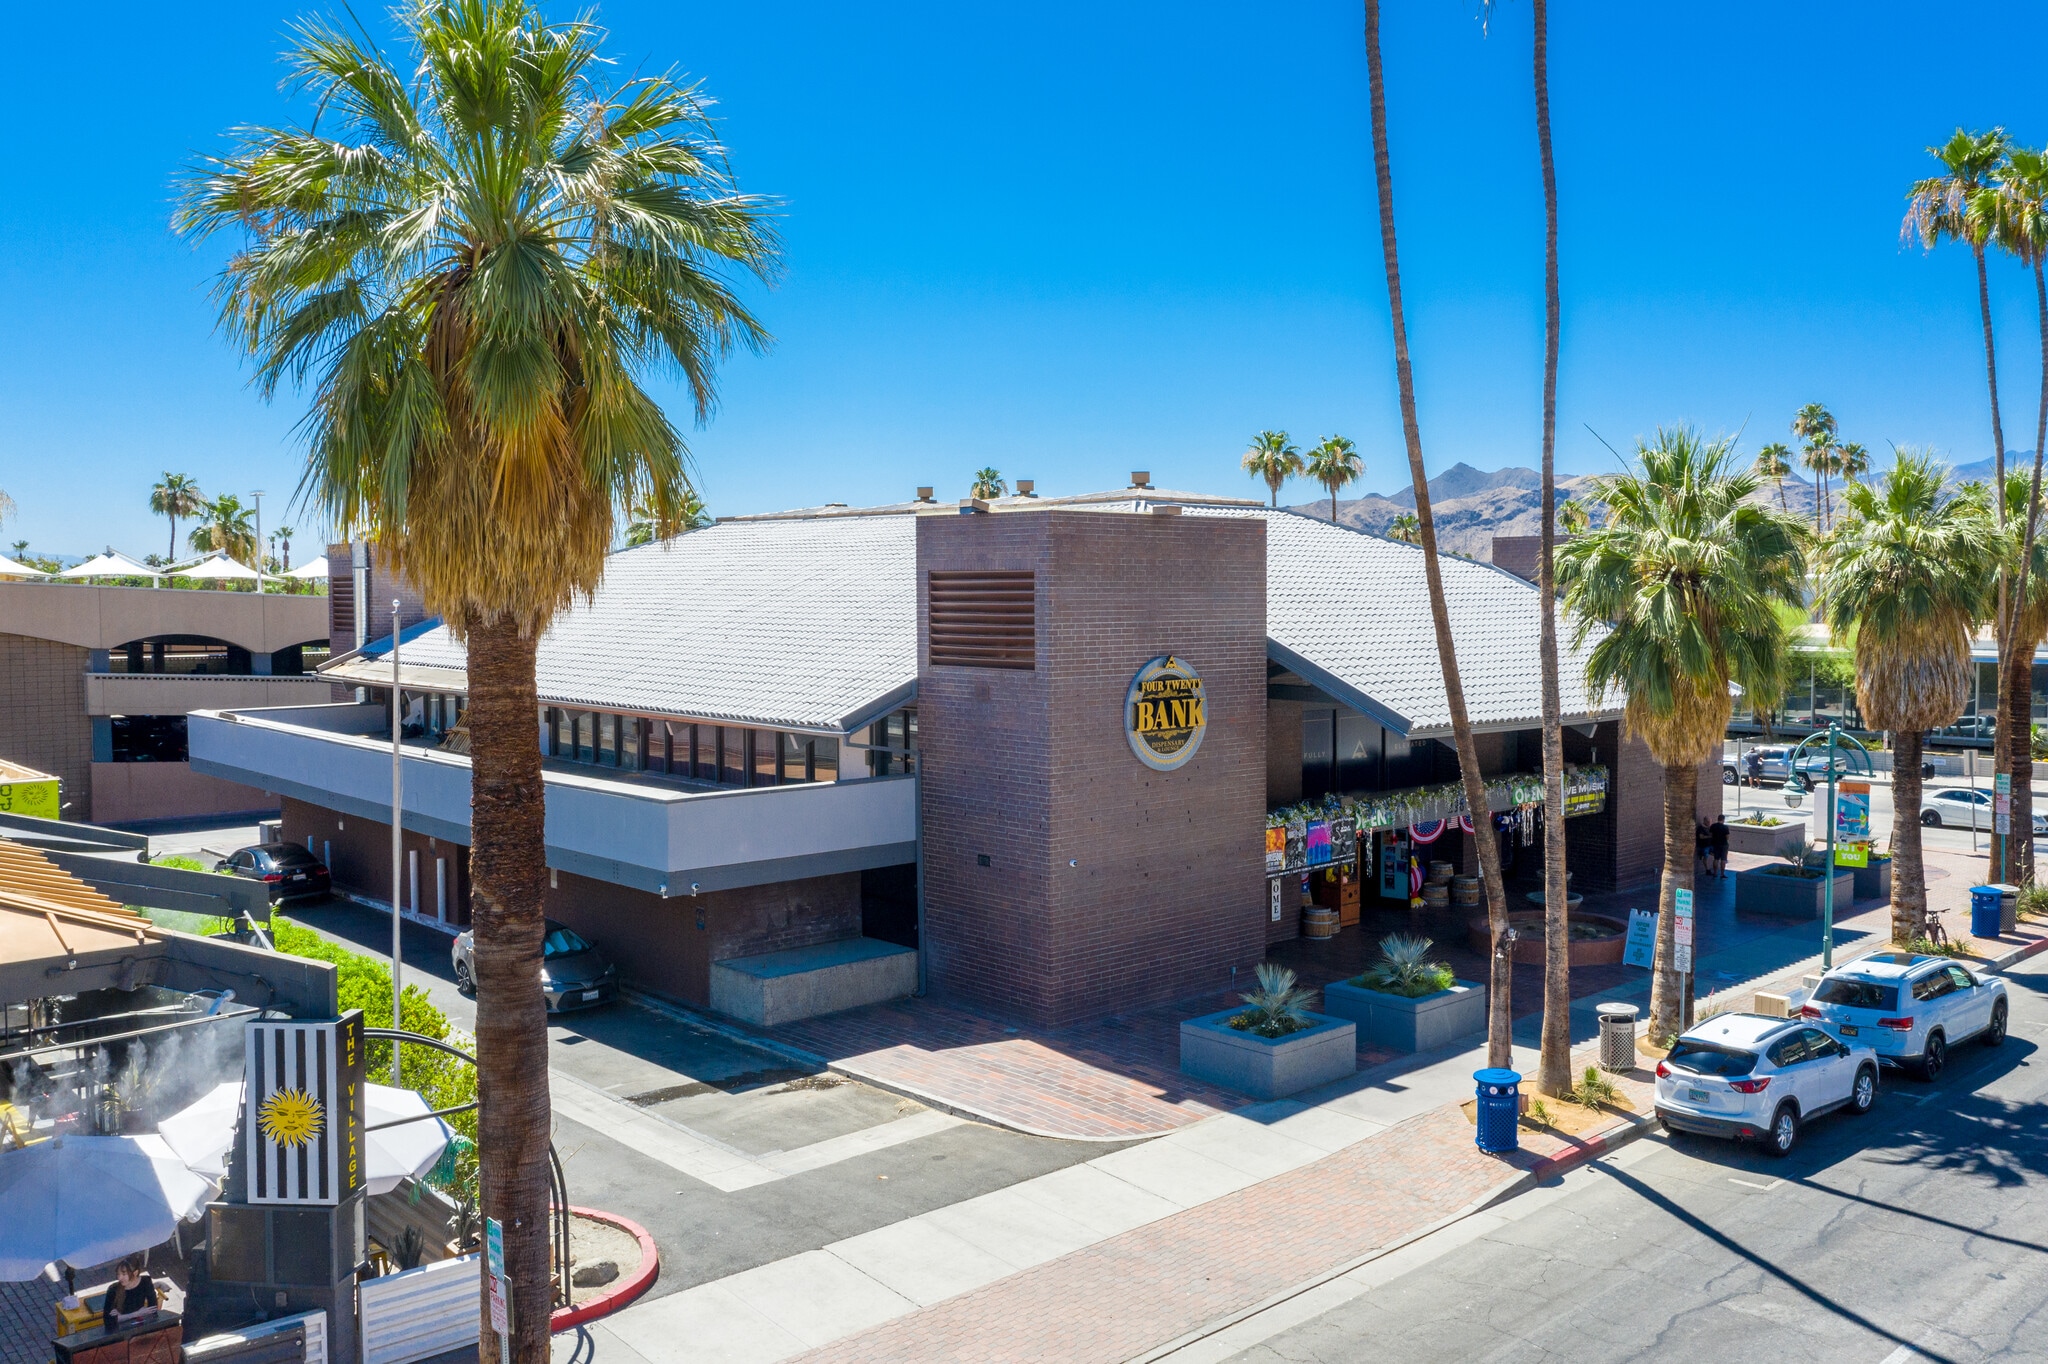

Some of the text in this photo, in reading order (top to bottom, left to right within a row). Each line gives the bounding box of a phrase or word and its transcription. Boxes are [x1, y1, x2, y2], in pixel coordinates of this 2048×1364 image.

[1142, 678, 1203, 692] FOUR TWENTY
[1137, 698, 1206, 732] BANK
[1394, 740, 1427, 750] ELEVATED
[1303, 751, 1326, 760] FULLY
[1841, 853, 1860, 861] YOU
[346, 1023, 357, 1189] THE VILLAGE
